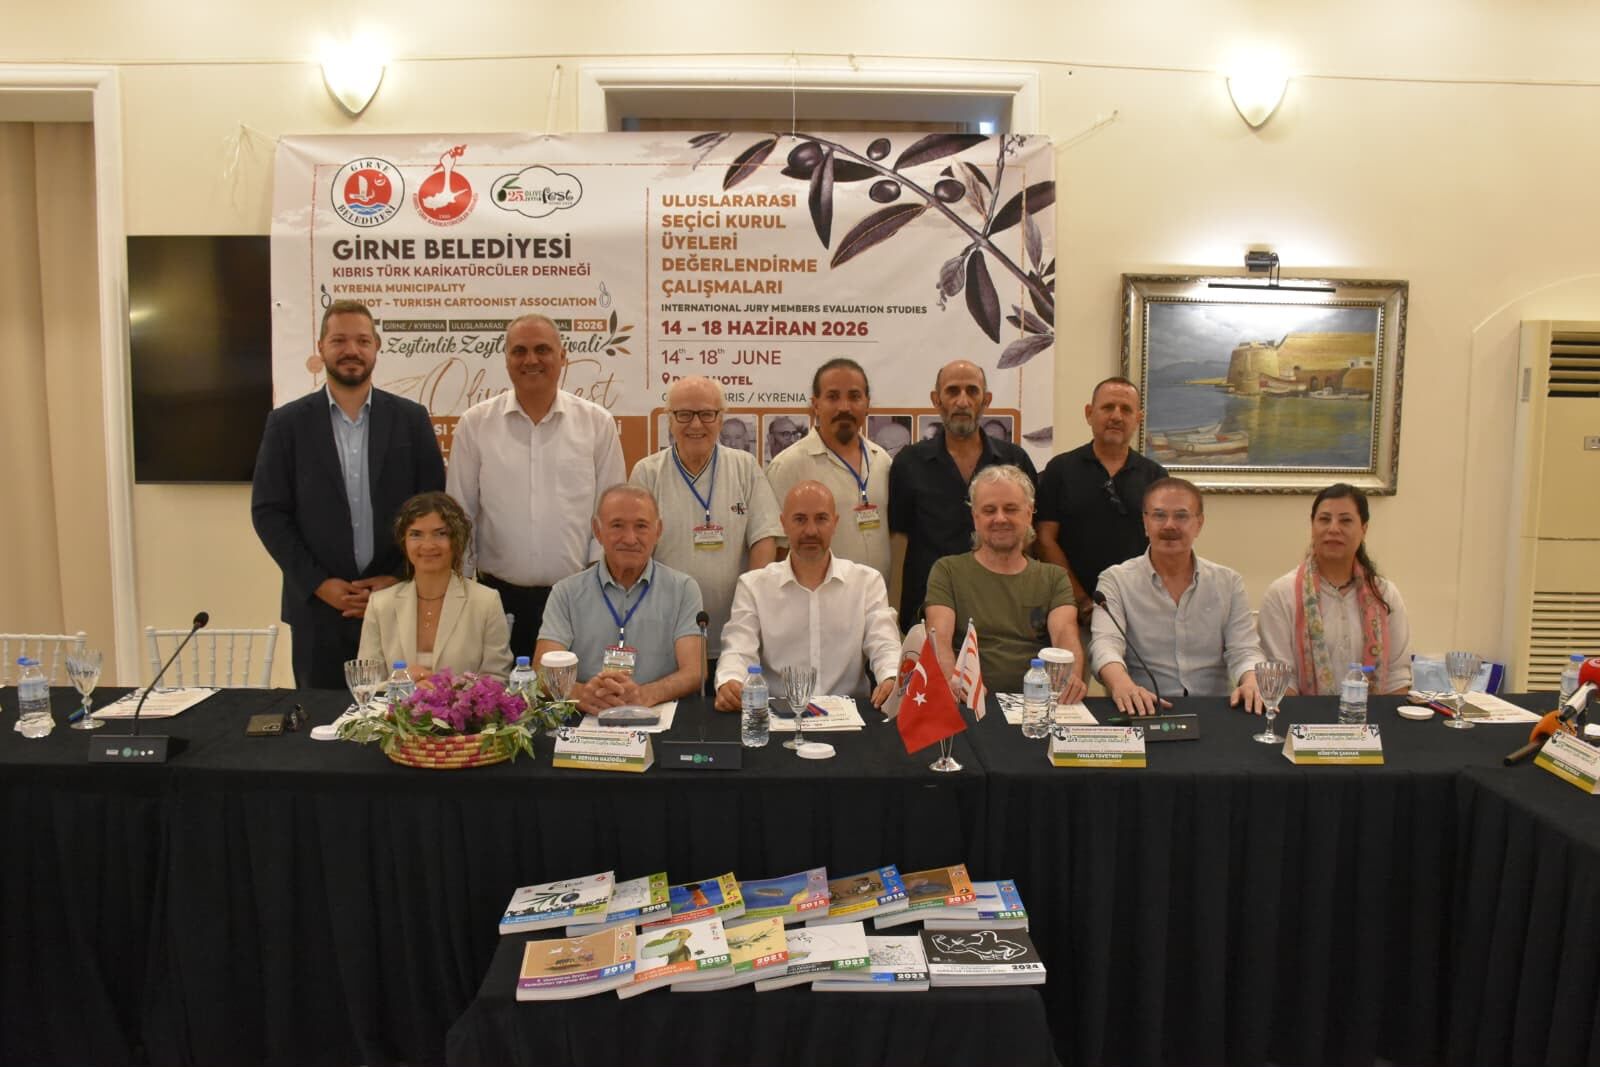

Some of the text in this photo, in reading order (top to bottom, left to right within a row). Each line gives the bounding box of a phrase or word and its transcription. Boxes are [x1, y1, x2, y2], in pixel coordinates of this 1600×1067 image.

[662, 194, 796, 207] ULUSLARARASI
[662, 212, 786, 232] SEÇİCİ KURUL
[332, 233, 572, 261] GİRNE BELEDİYESİ
[661, 232, 738, 250] ÜYELERİ
[332, 261, 591, 278] KIBRIS TÜRK KARİKATÜRCÜLER DERNEĞİ
[661, 254, 817, 273] DEĞERLENDİRME
[333, 283, 466, 293] KYRENIA MUNICIPALITY
[661, 279, 783, 298] ÇALIŞMALARI
[394, 298, 441, 307] TURKISH
[444, 297, 517, 307] CARTOONIST
[520, 297, 597, 306] ASSOCIATION
[661, 304, 928, 315] INTERNATIONAL JURY MEMBERS EVALUATION STUDIES
[577, 320, 604, 330] 2026
[661, 320, 682, 335] 14
[702, 320, 722, 335] 18
[727, 316, 816, 336] HAZİRAN
[821, 320, 869, 336] 2026
[732, 350, 782, 365] JUNE
[716, 375, 753, 386] OTEL
[757, 392, 807, 403] KYRENIA
[947, 894, 974, 905] 2017
[699, 954, 728, 967] 2020
[756, 952, 784, 964] 2021
[837, 957, 865, 967] 2022
[1011, 962, 1039, 970] 2024
[897, 972, 925, 980] 2023
